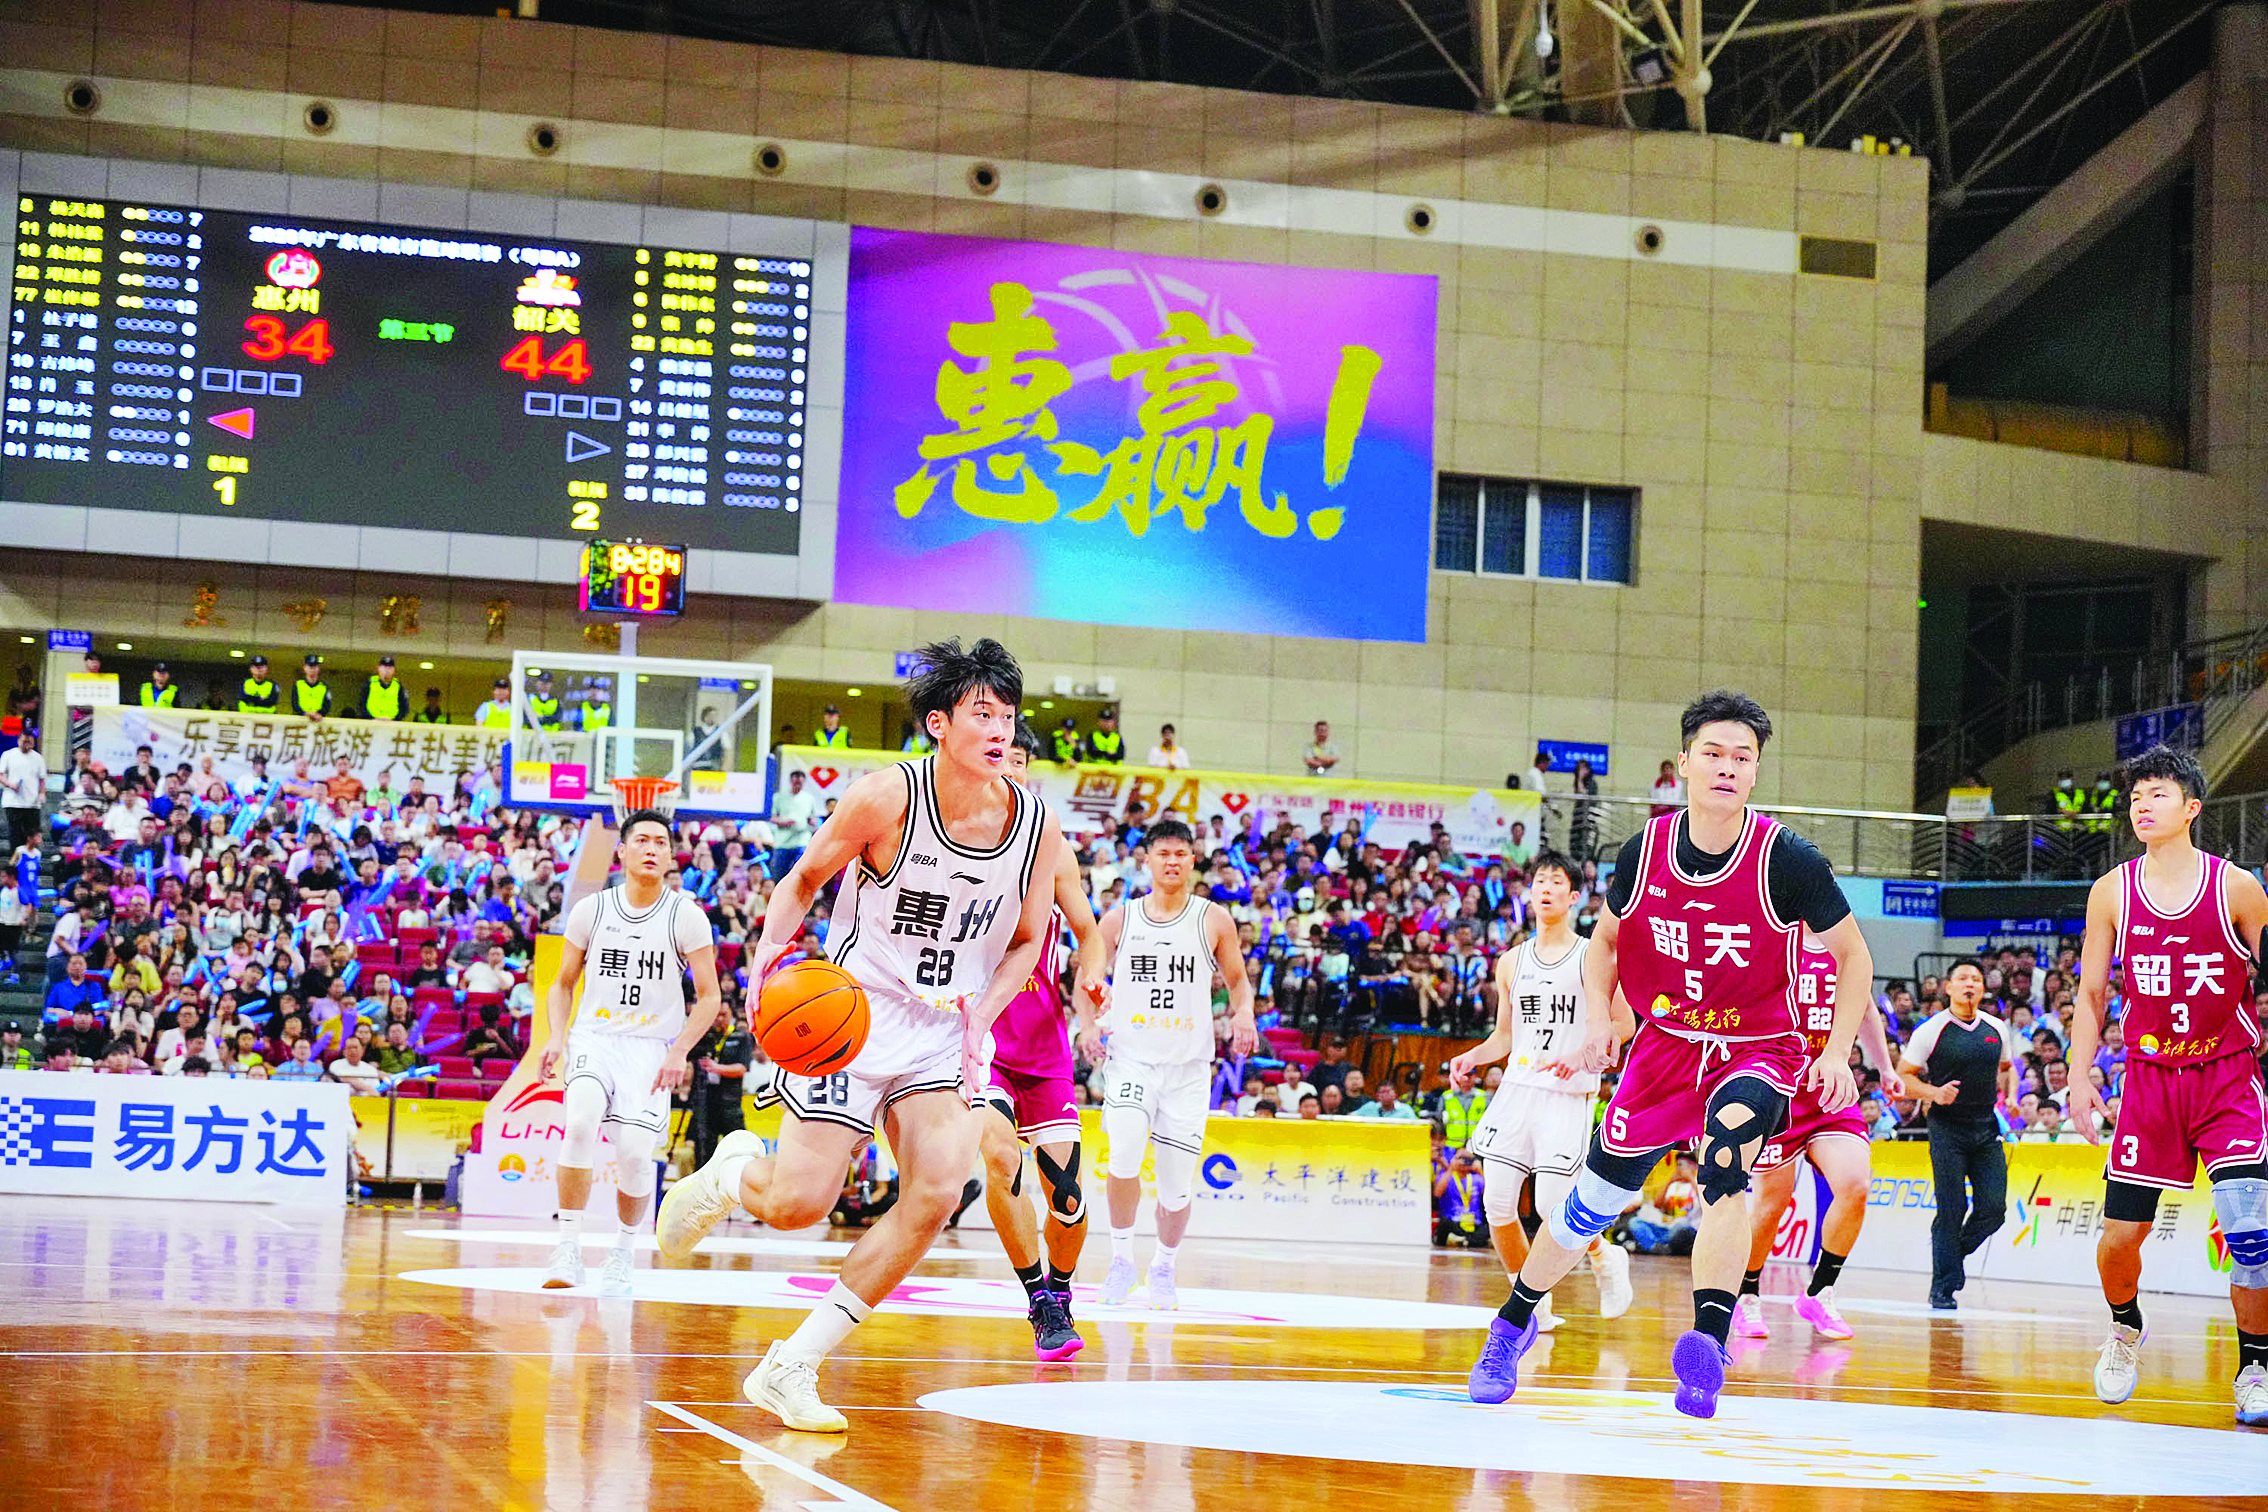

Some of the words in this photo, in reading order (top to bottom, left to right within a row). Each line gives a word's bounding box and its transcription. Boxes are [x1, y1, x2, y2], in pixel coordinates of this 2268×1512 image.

[251, 285, 320, 314] 惠州
[242, 314, 334, 365] 34
[500, 335, 593, 385] 44
[213, 476, 236, 505] 1
[570, 500, 601, 531] 2
[625, 574, 661, 611] 19
[179, 717, 373, 772] 乐享品质旅游
[891, 887, 1004, 943] 惠州
[1648, 916, 1751, 968] 韶关
[599, 948, 665, 980] 惠州
[916, 947, 956, 987] 28
[1131, 955, 1195, 983] 惠州
[2131, 952, 2225, 997] 韶关
[620, 984, 641, 1006] 18
[1150, 989, 1174, 1009] 22
[1684, 969, 1703, 1002] 5
[1519, 994, 1576, 1024] 惠州
[1807, 1006, 1832, 1030] 22
[2170, 1003, 2190, 1033] 3
[1534, 1029, 1554, 1050] 7
[808, 1071, 849, 1107] 28
[1120, 1082, 1144, 1102] 22
[113, 1103, 326, 1177] 易方达
[1611, 1106, 1630, 1142] 5
[2120, 1134, 2139, 1167] 3
[1261, 1162, 1418, 1193] 太平洋建设
[1263, 1191, 1310, 1204] Pacific
[1331, 1194, 1418, 1208] Construction
